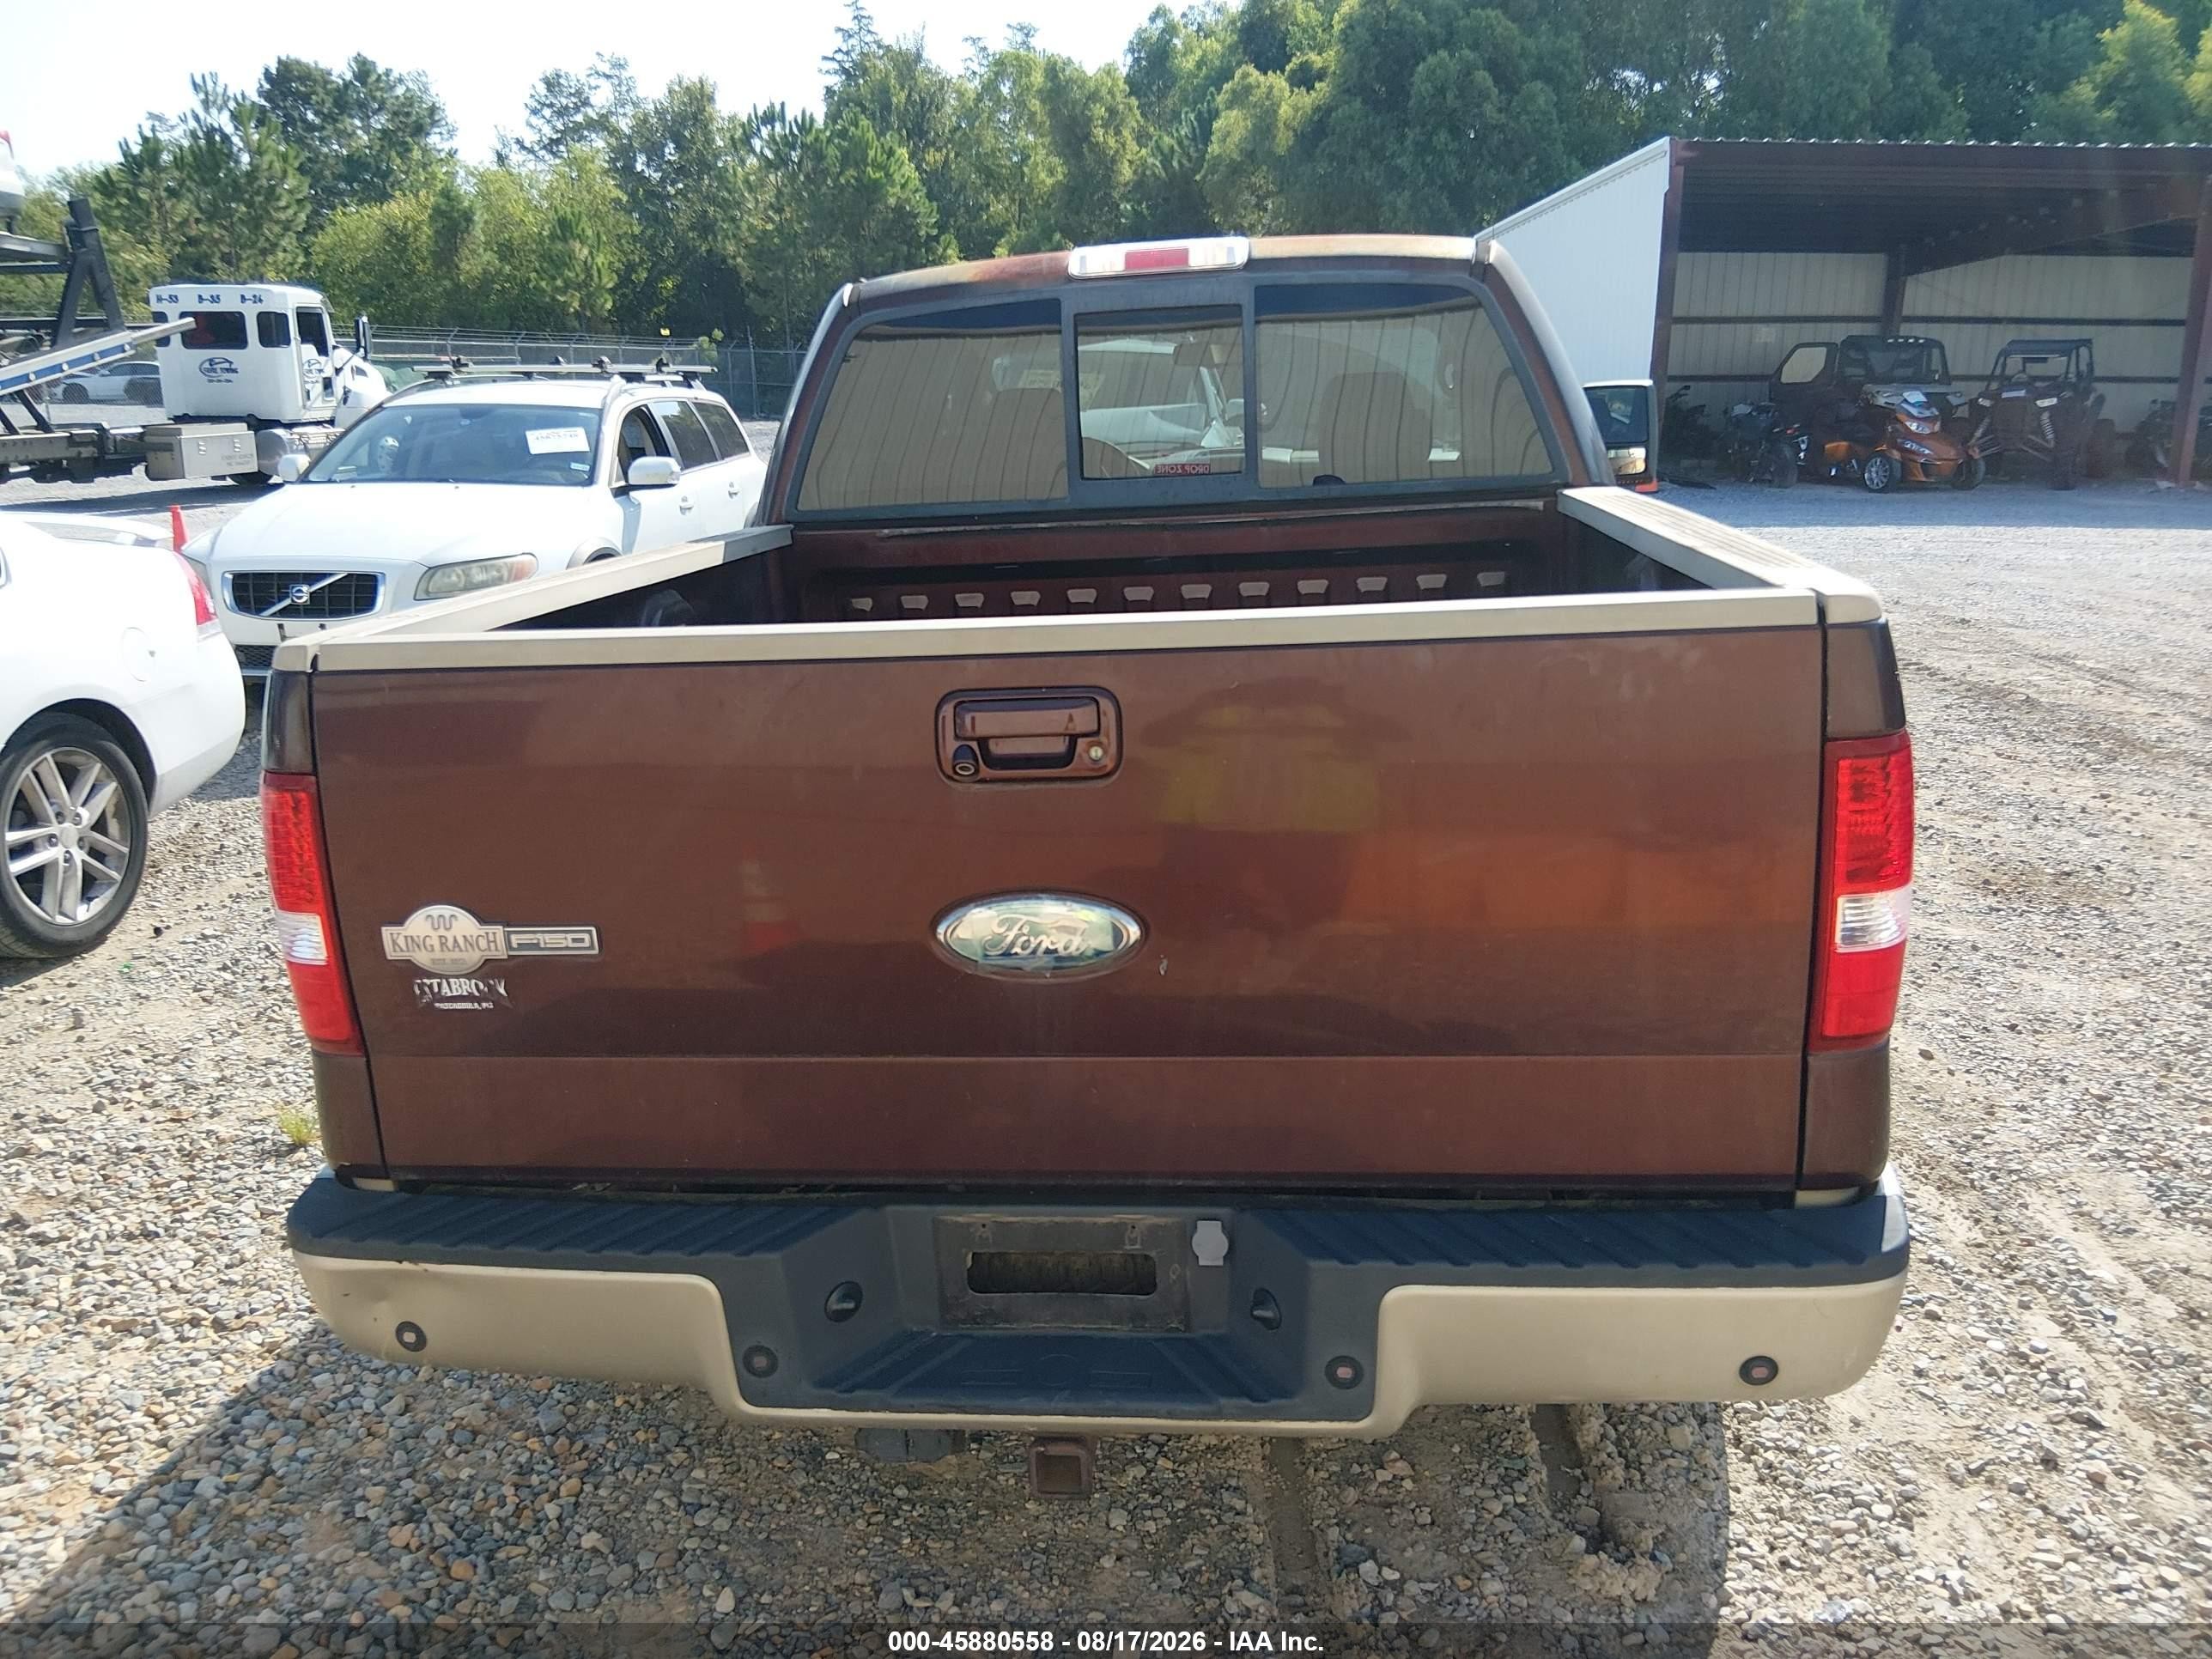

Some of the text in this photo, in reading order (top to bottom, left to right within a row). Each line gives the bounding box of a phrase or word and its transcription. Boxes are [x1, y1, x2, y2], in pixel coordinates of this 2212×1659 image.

[389, 932, 501, 954] KING RANCH
[510, 933, 592, 948] F150
[982, 914, 1093, 957] Ford
